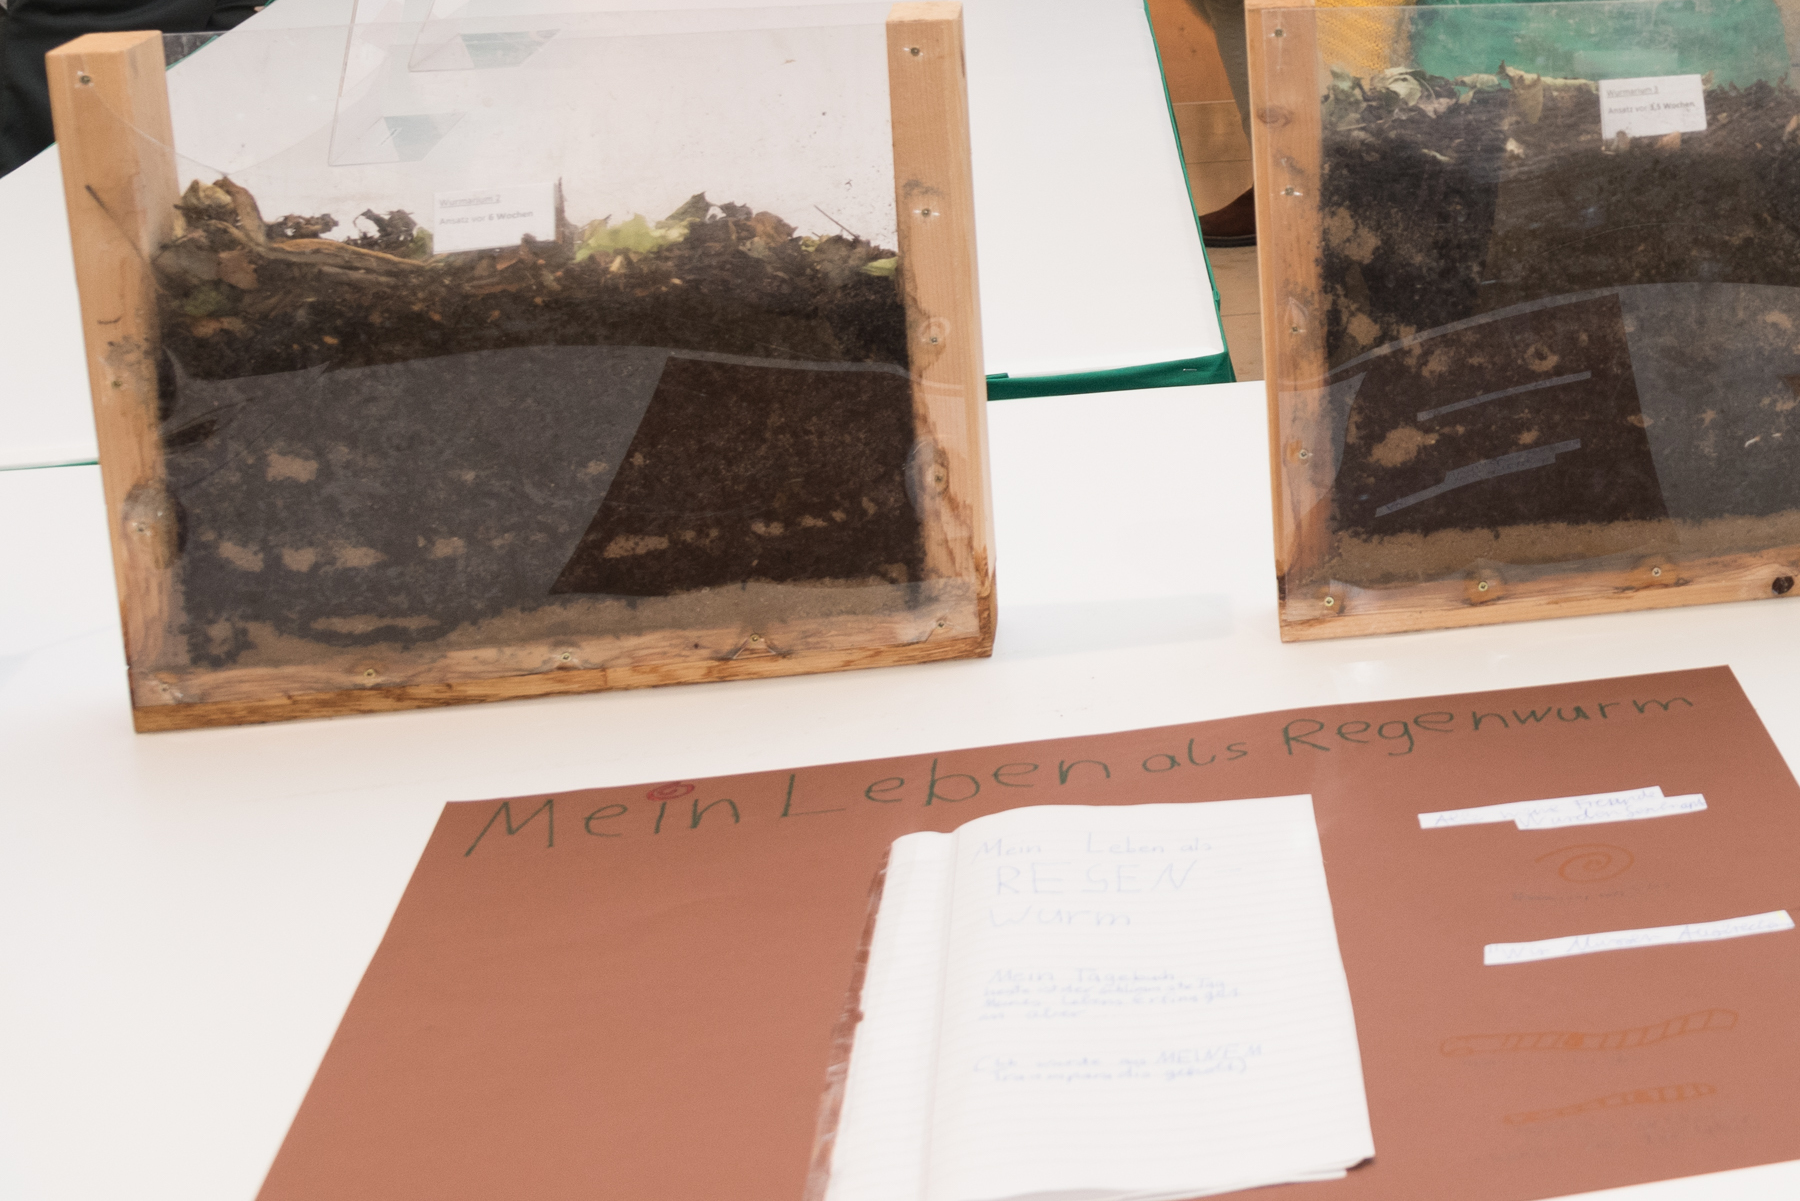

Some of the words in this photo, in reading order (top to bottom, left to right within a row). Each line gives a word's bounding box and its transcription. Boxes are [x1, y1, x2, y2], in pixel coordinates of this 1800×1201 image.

[1663, 100, 1696, 109] Wochen
[439, 217, 469, 225] Ansatz
[496, 210, 534, 220] Wochen
[464, 780, 741, 858] Mein
[779, 758, 1111, 818] Leben
[1142, 738, 1249, 774] als
[1281, 693, 1694, 757] Regenwurm
